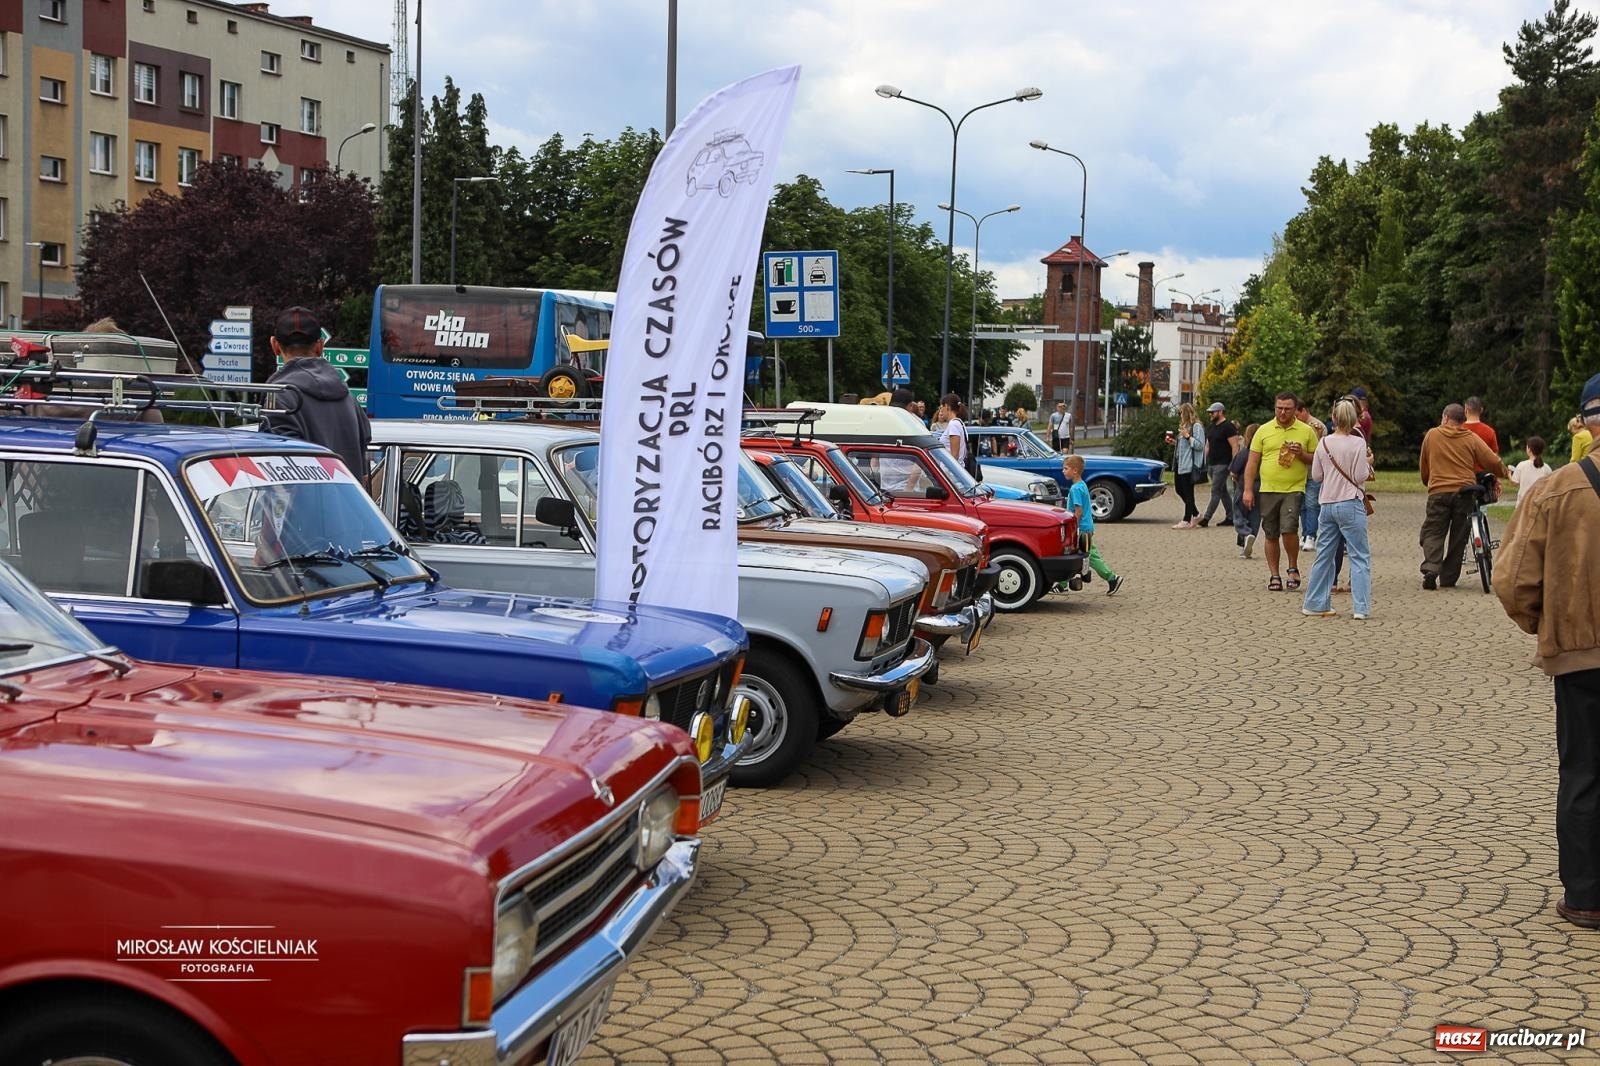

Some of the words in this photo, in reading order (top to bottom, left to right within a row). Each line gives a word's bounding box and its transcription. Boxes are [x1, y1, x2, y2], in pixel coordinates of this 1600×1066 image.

[644, 216, 689, 359] CZASÓW
[424, 310, 465, 332] eko
[710, 275, 742, 381] OKOCE
[219, 325, 244, 333] Centrum
[798, 325, 814, 333] 500
[223, 341, 248, 350] Dworzec
[434, 331, 489, 348] okna
[218, 358, 239, 366] Poczta
[392, 356, 436, 364] INTOURO
[406, 369, 446, 381] OTWÓRZ
[447, 371, 461, 383] SIĘ
[462, 372, 475, 381] NA
[413, 382, 441, 393] NOWE
[668, 382, 697, 437] PRL
[256, 456, 331, 482] Marlboro
